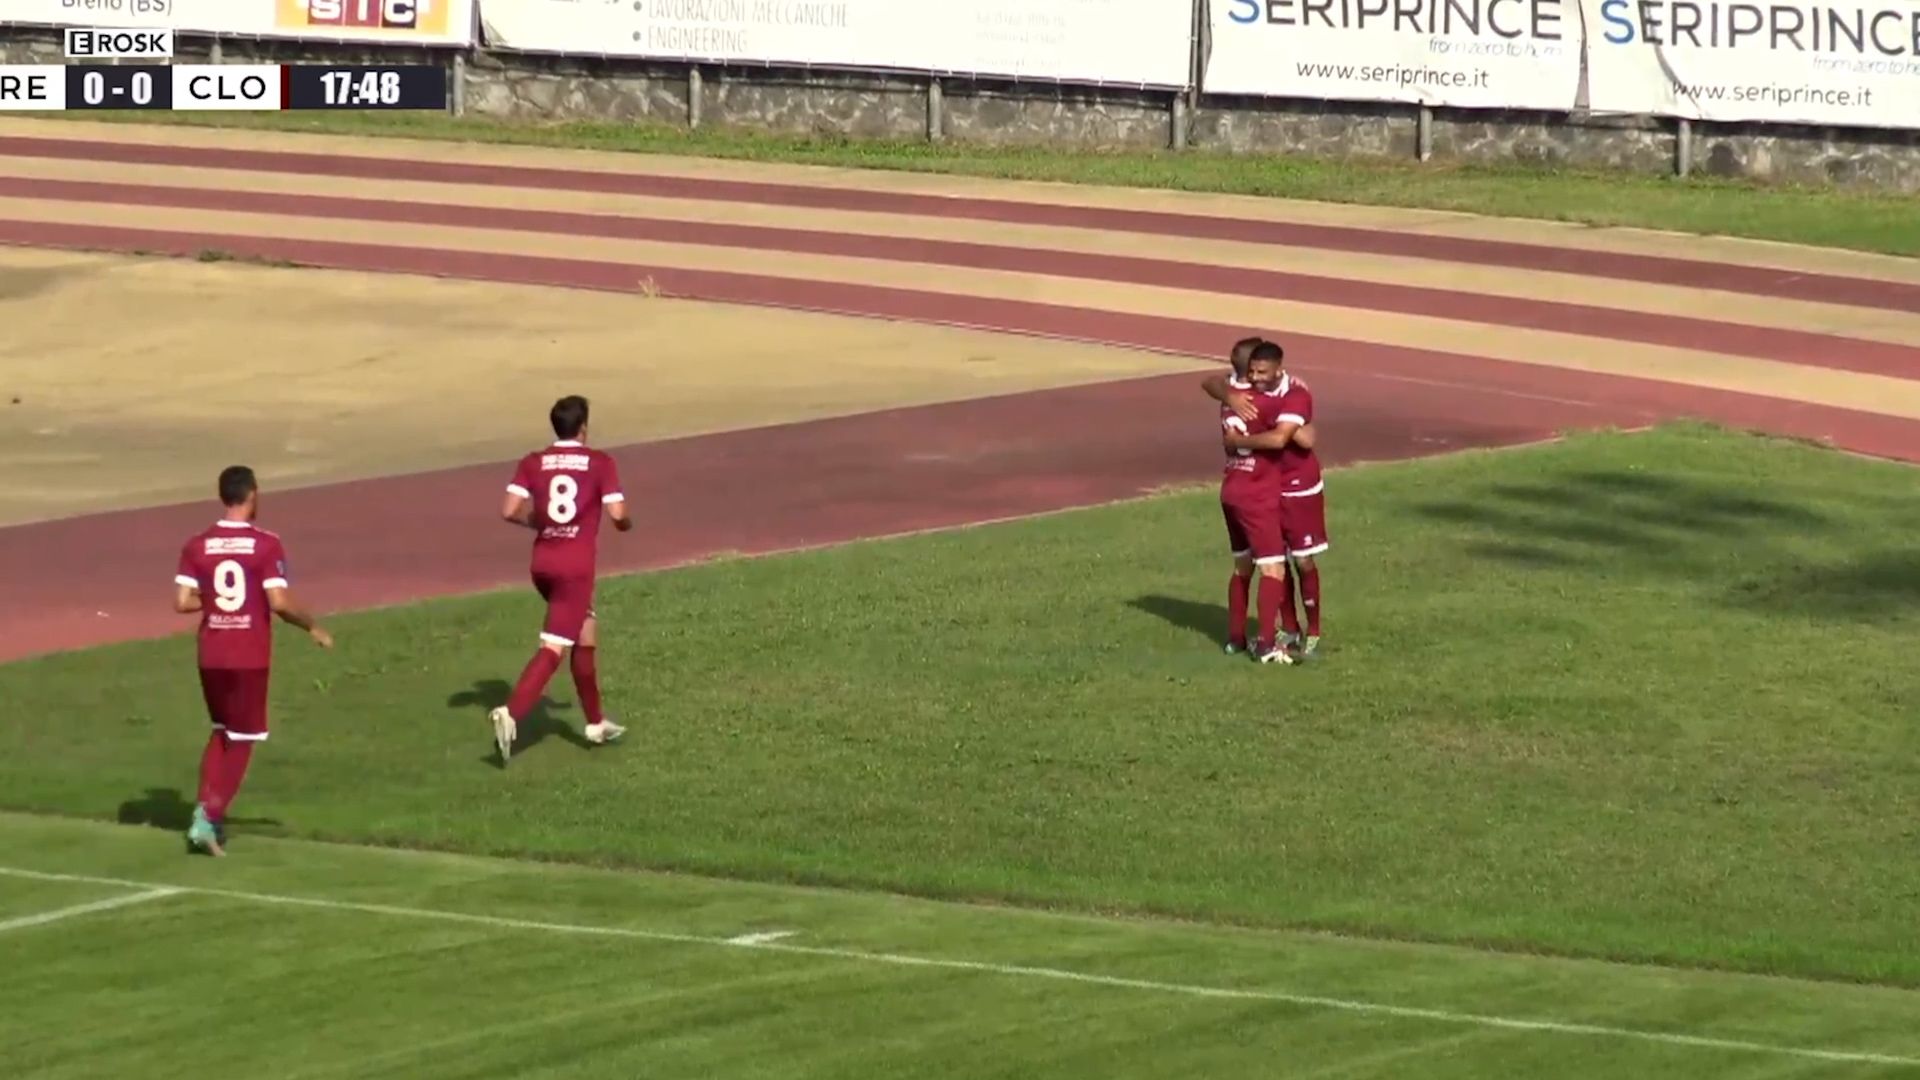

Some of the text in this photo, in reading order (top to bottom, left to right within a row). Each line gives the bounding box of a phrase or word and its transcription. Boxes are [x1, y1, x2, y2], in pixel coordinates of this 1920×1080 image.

[752, 0, 849, 28] MECCANICHE
[1228, 0, 1562, 40] SERIPRINCE
[648, 25, 748, 52] ENGINEERING
[1296, 61, 1489, 88] www.seriprince.it
[1672, 80, 1872, 107] www.seriprince.it
[547, 474, 578, 524] 8
[214, 559, 246, 612] 9
